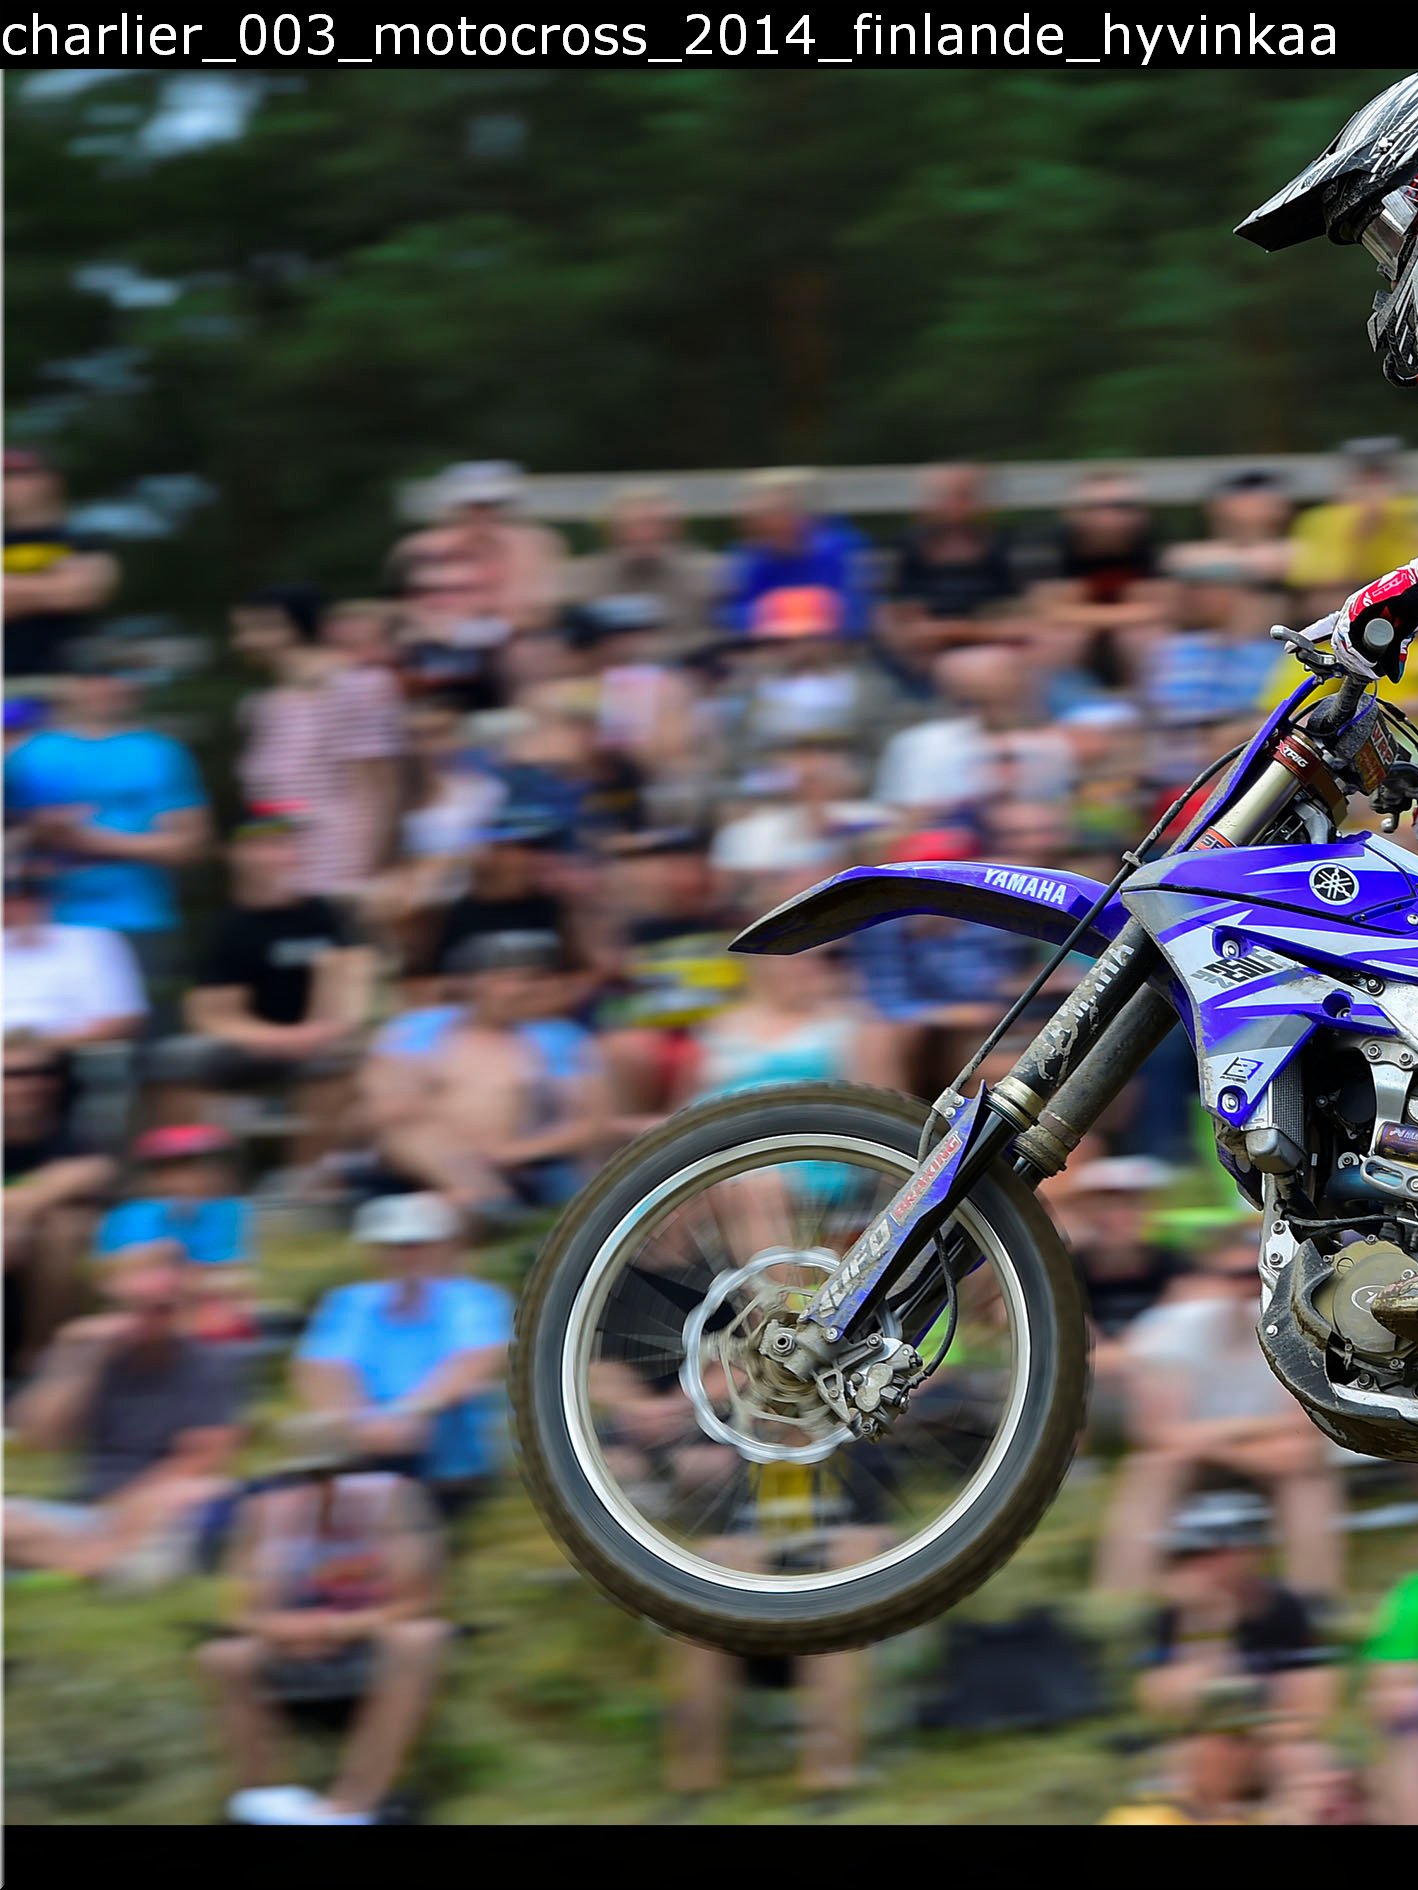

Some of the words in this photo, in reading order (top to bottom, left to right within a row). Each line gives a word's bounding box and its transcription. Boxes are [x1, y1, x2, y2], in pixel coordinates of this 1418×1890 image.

[1274, 738, 1309, 769] XTRIG
[983, 867, 1069, 906] YAMAHA
[892, 1135, 963, 1220] BRAKING
